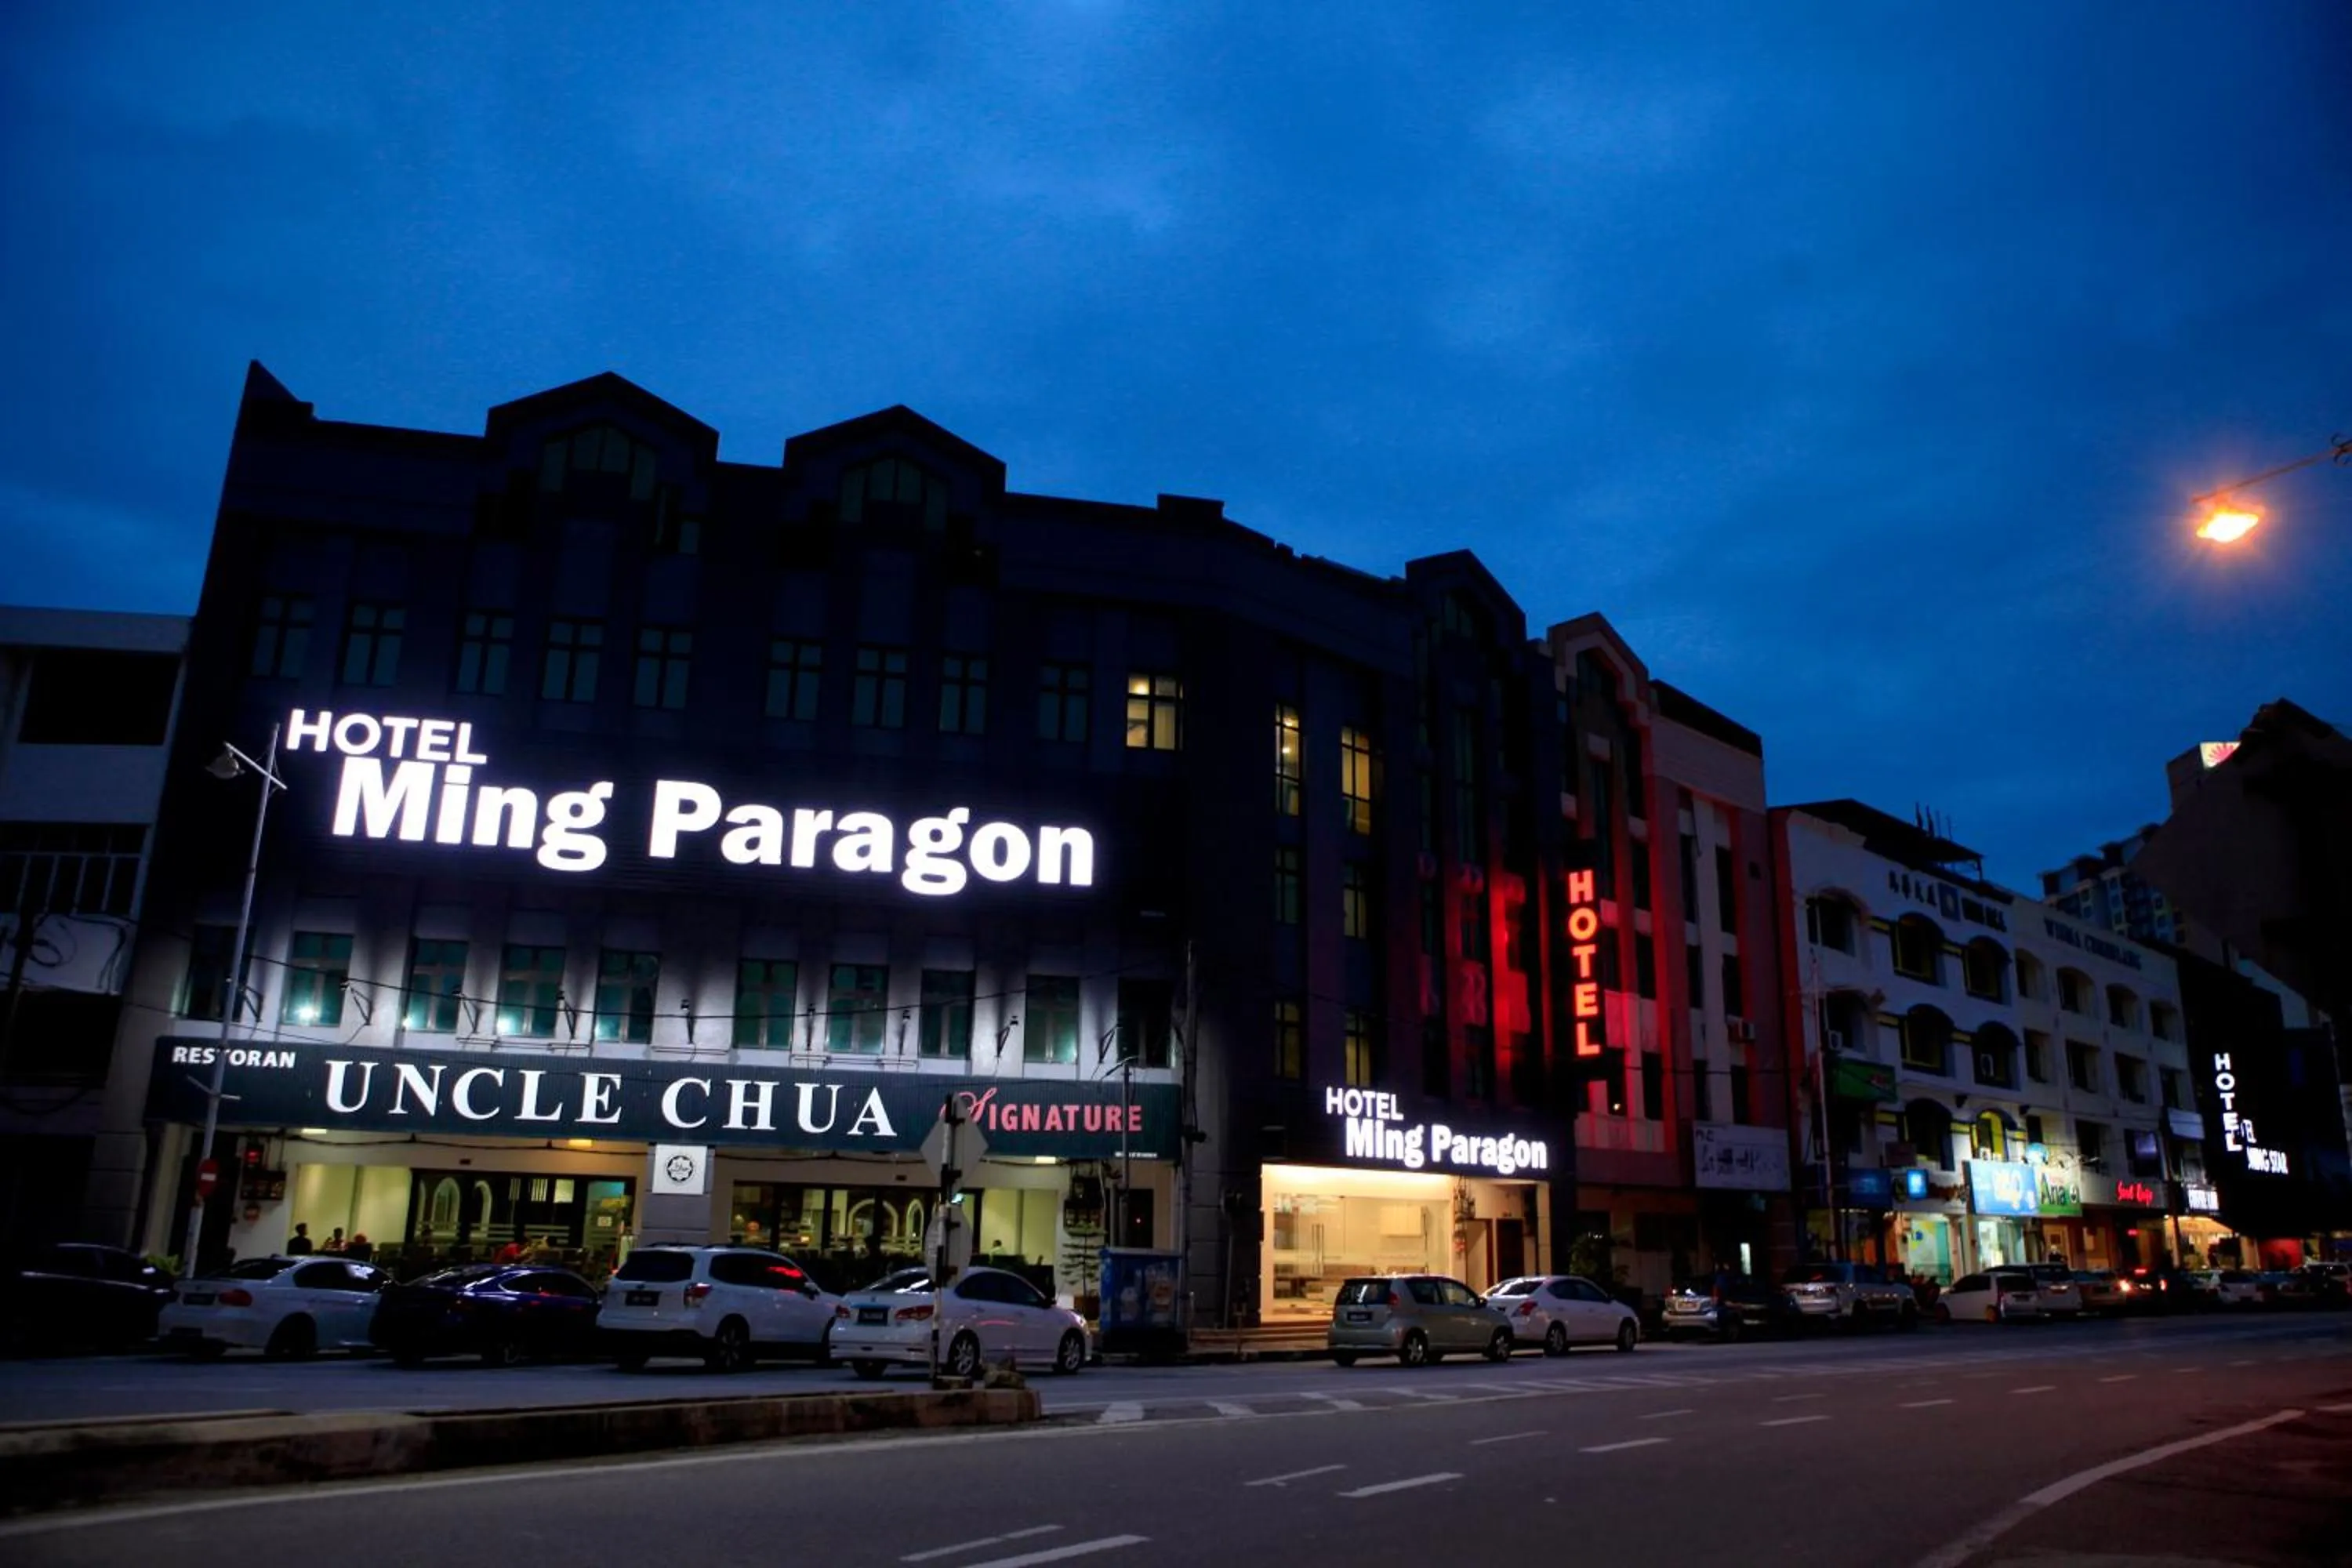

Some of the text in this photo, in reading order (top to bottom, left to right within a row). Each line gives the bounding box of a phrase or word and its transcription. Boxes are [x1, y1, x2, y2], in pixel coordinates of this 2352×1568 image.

[285, 708, 488, 765] HOTEL
[332, 754, 1094, 896] Ming Paragon
[1567, 869, 1601, 1057] HOTEL
[324, 1058, 898, 1138] UNCLE CHUA
[1326, 1087, 1404, 1121] HOTEL
[2214, 1052, 2243, 1152] HOTEL
[1345, 1116, 1548, 1174] Ming Paragon
